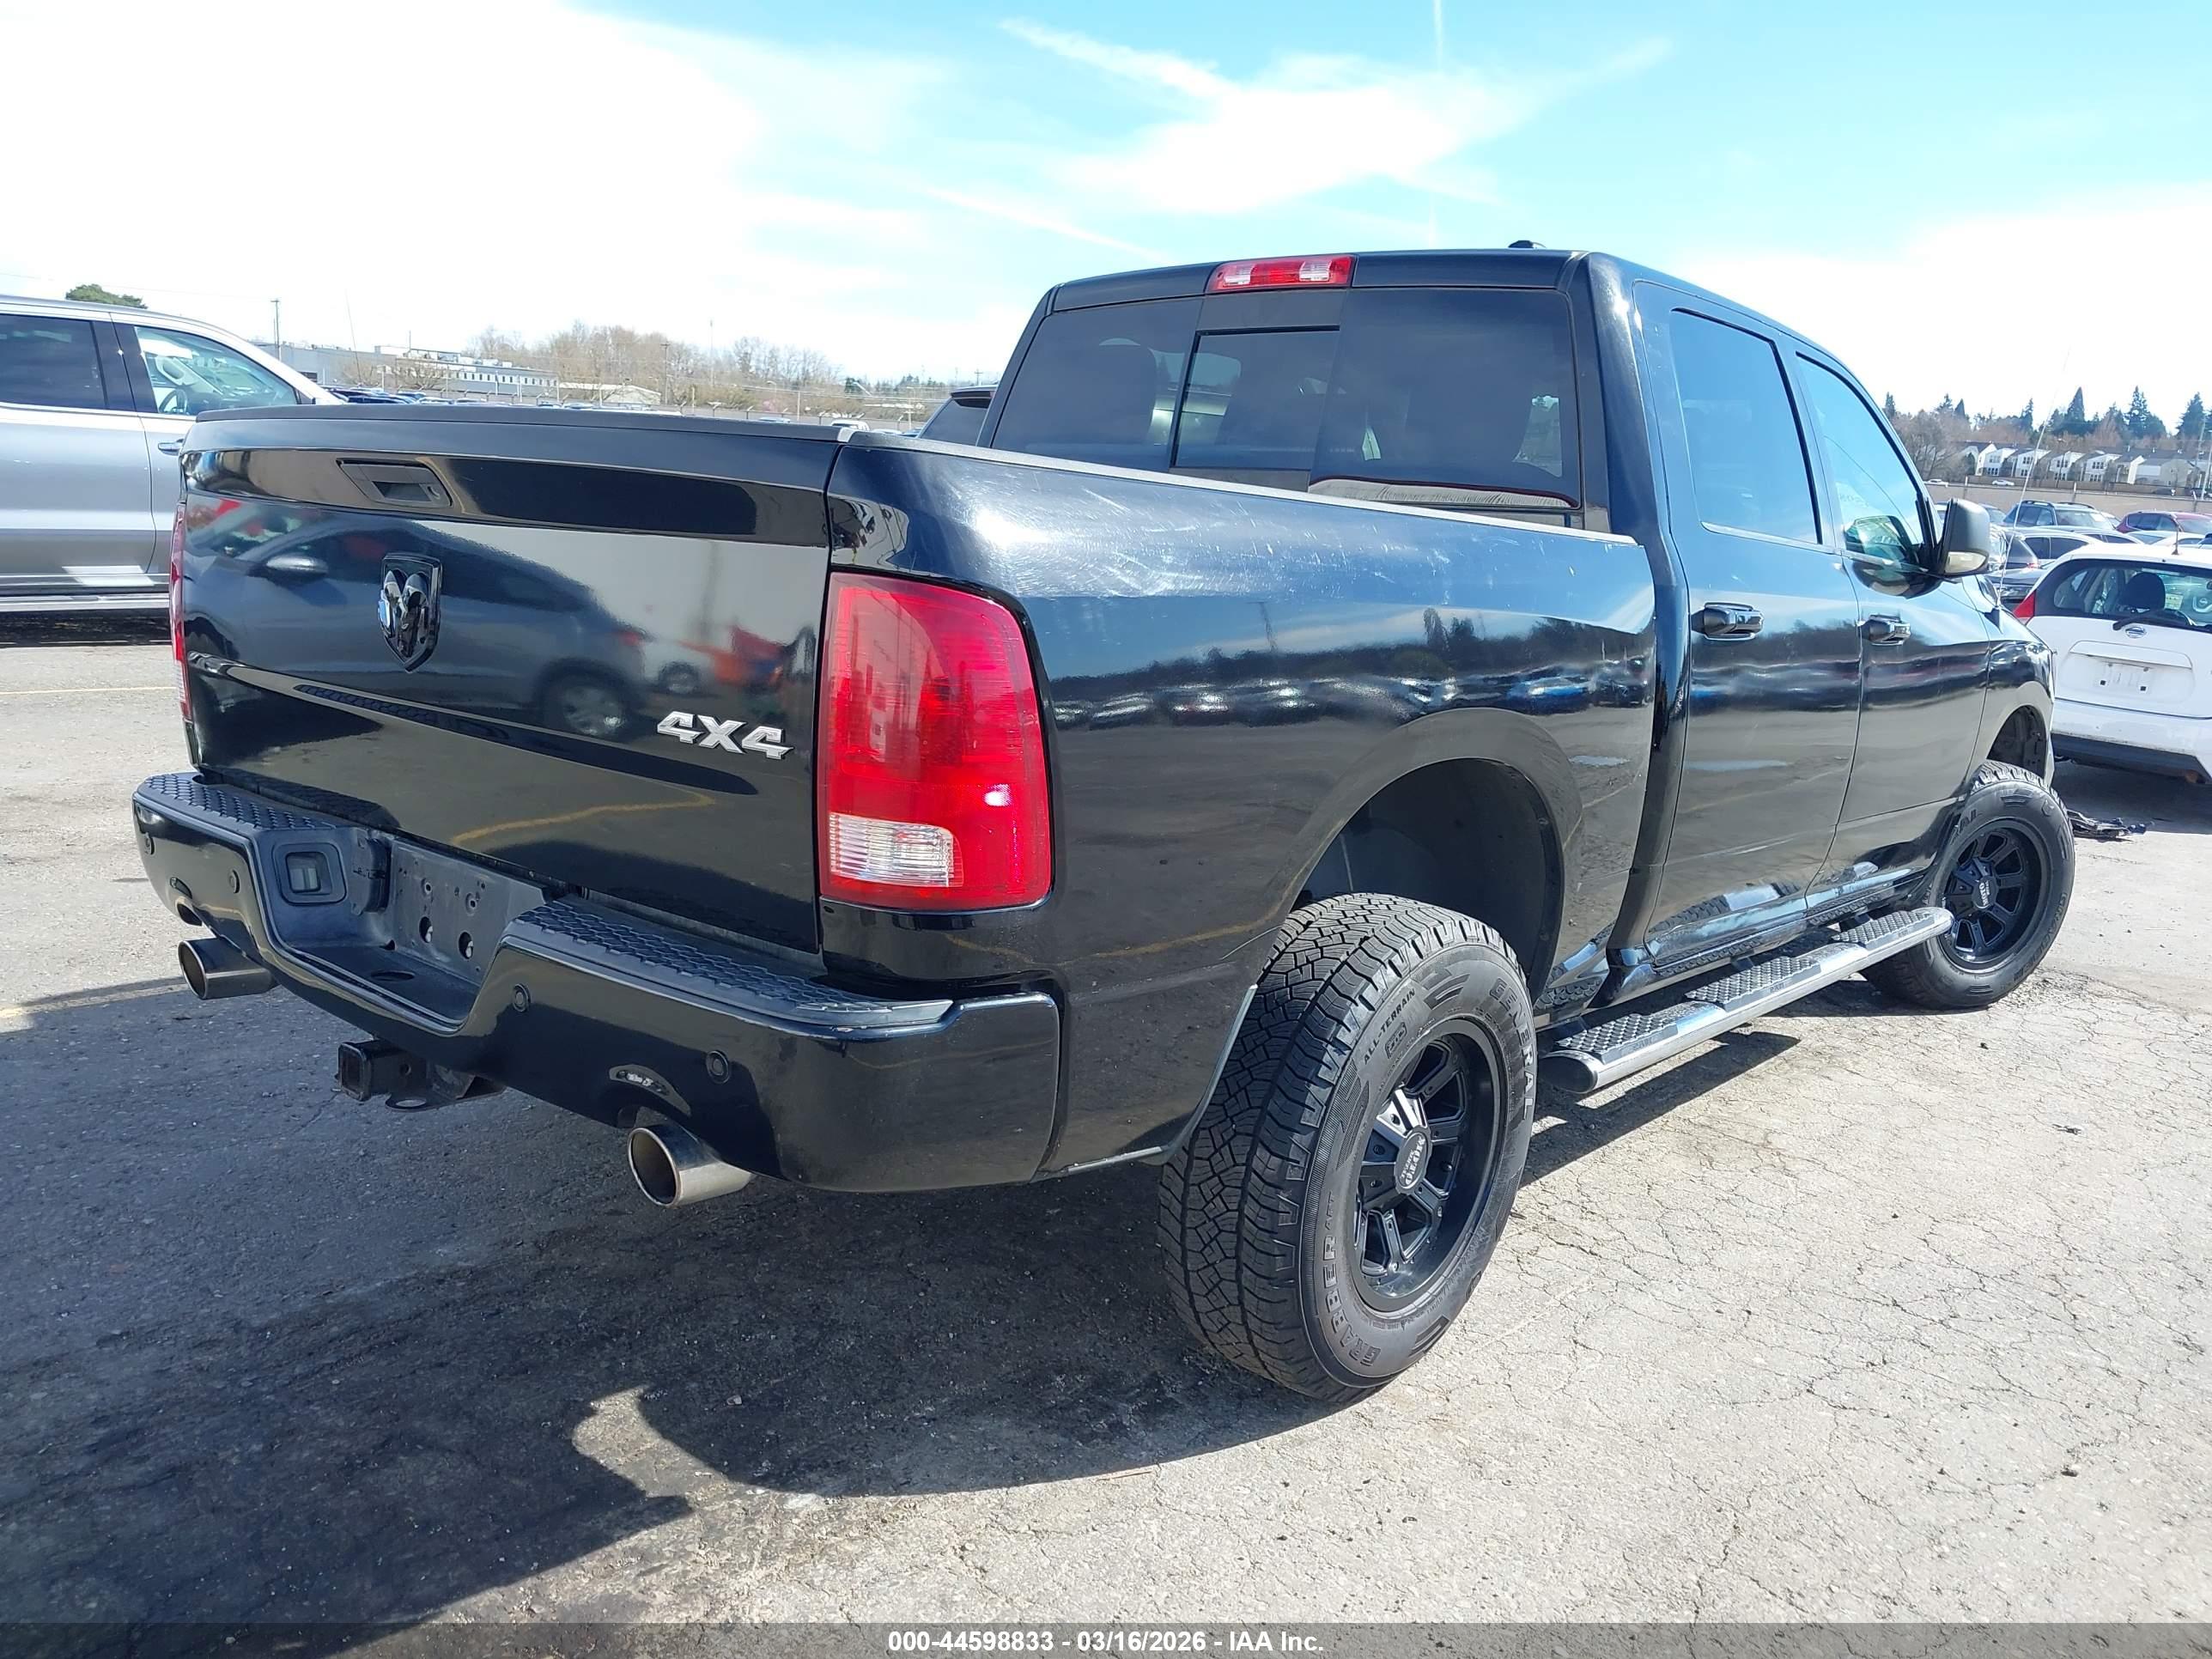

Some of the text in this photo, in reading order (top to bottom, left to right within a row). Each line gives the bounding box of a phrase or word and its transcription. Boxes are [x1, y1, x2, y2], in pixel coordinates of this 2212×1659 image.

[657, 710, 795, 760] 4X4
[1363, 988, 1416, 1065] ALL-TERRAIN
[1489, 977, 1535, 1121] GENERAL
[1405, 1135, 1425, 1185] MOTO
[1322, 1236, 1381, 1367] GRABBER
